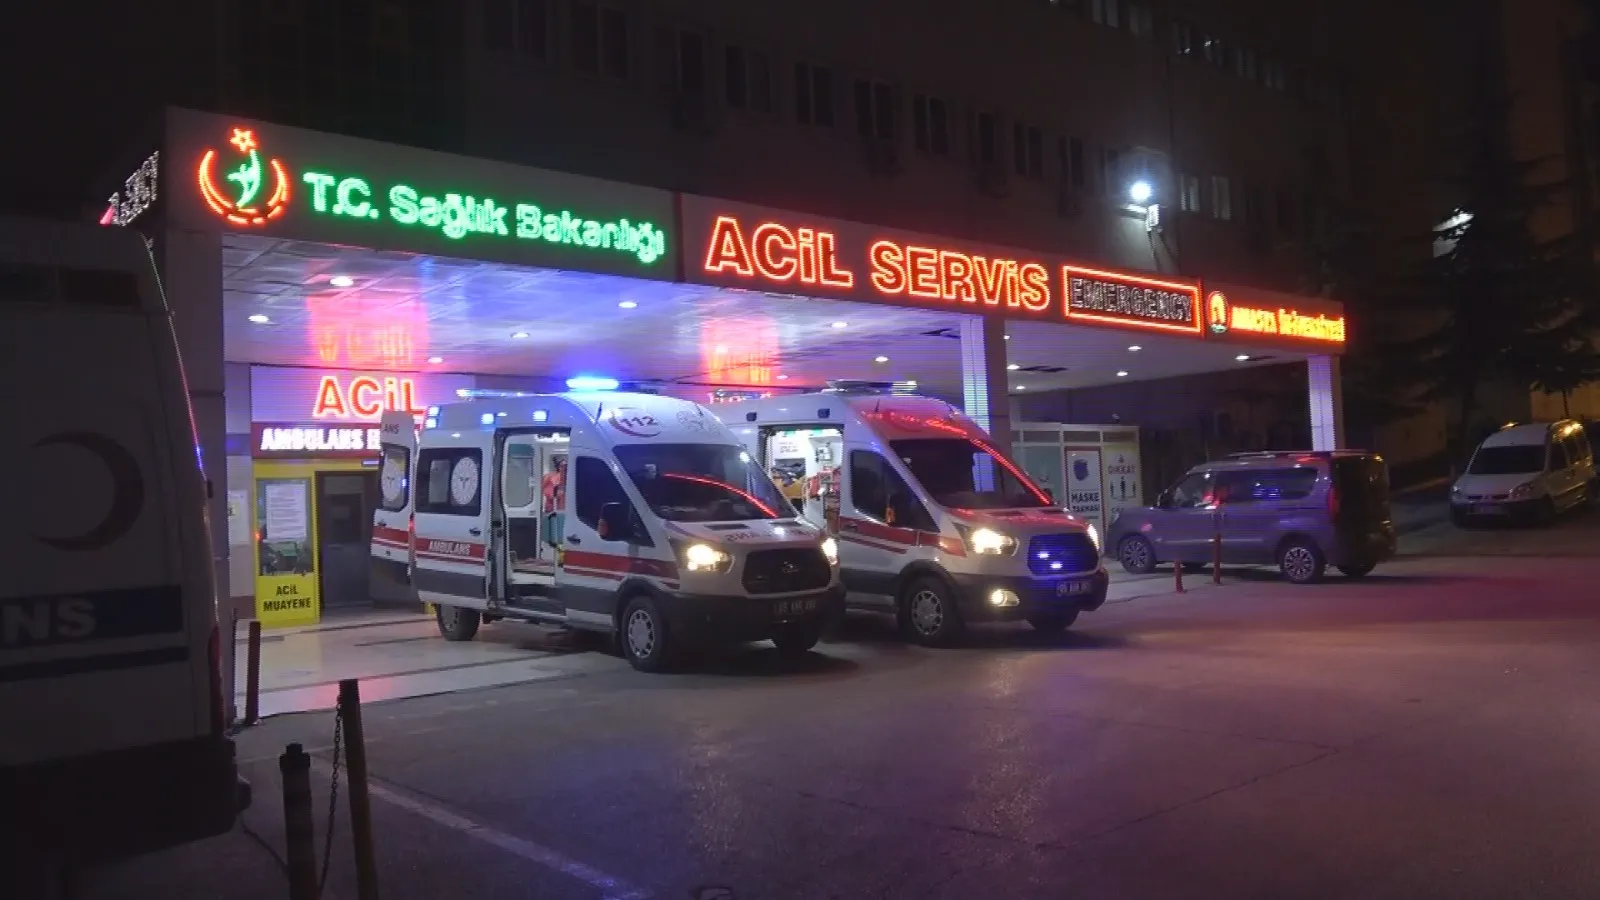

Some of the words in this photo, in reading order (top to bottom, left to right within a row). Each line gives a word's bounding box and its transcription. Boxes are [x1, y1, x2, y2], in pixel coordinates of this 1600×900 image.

[303, 172, 380, 219] T.C.
[389, 185, 508, 239] Sağlık
[515, 203, 664, 264] Bakanlığı
[1069, 277, 1193, 323] EMERGENCY
[622, 414, 659, 428] 112
[1071, 492, 1100, 503] MASKE
[429, 540, 471, 556] AMBULANS
[263, 597, 311, 612] MUAYENE
